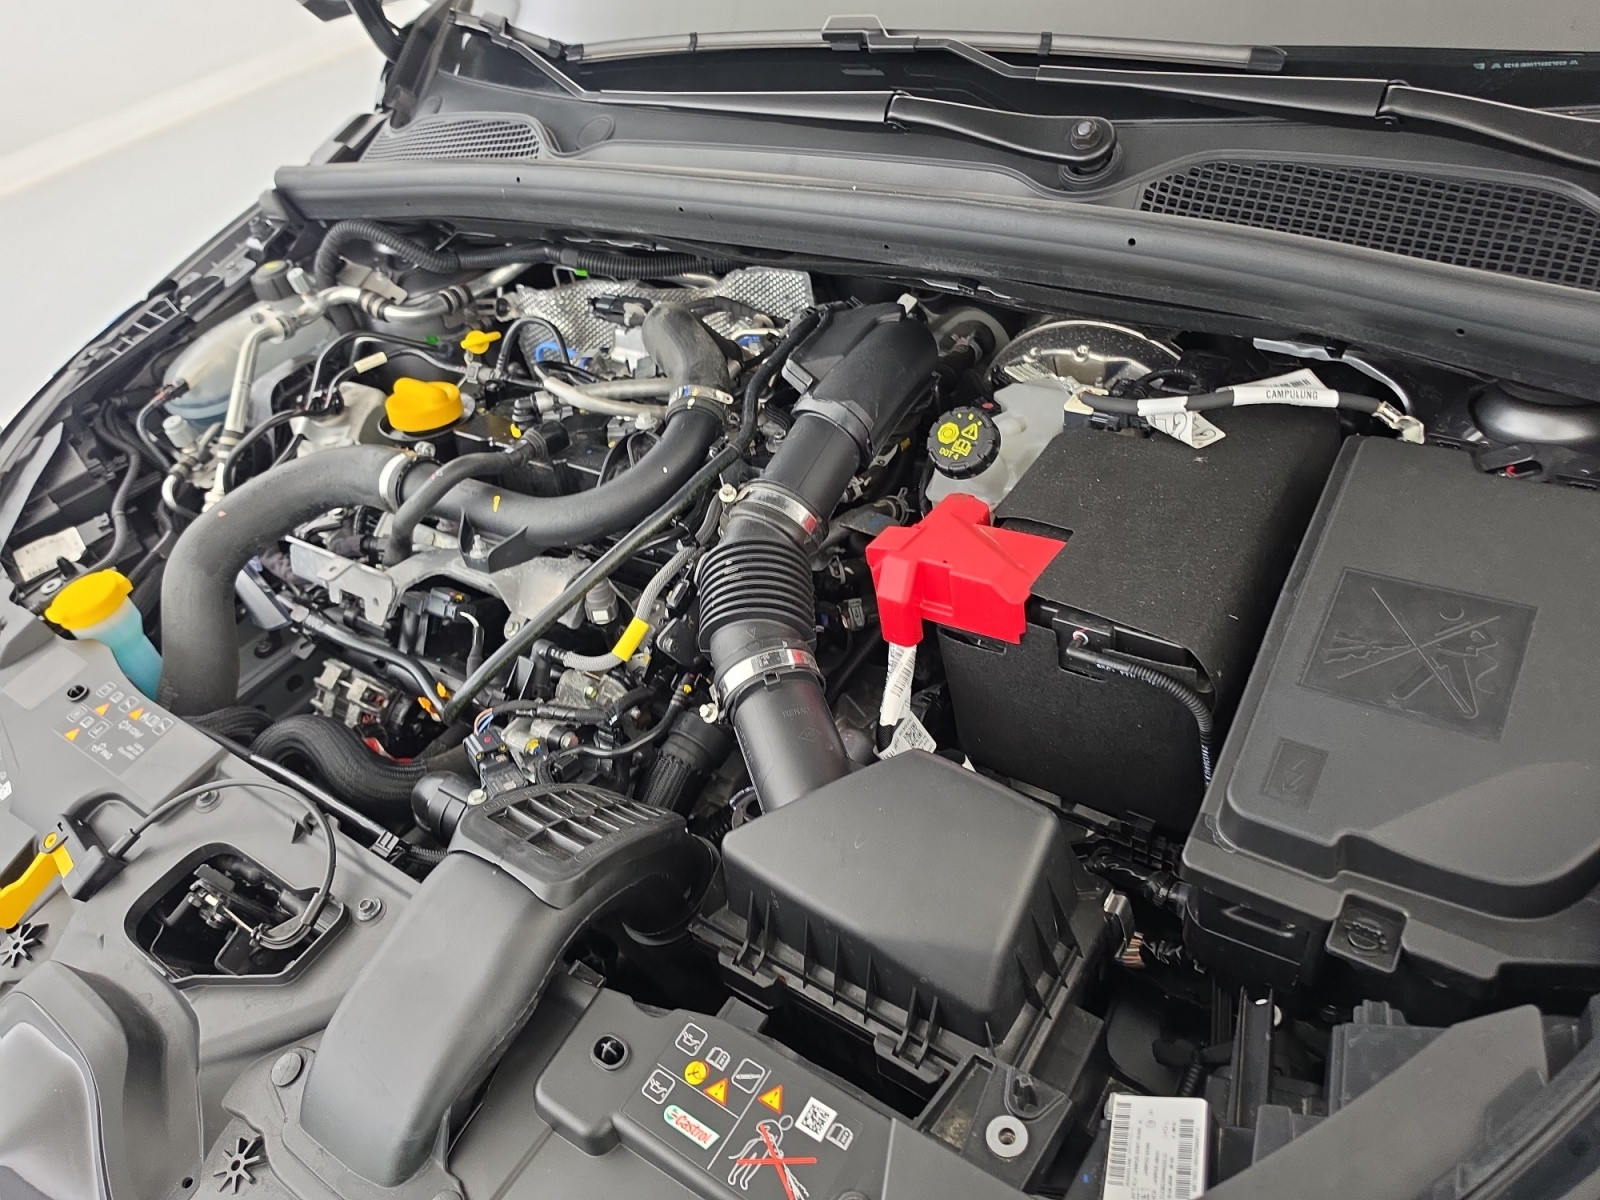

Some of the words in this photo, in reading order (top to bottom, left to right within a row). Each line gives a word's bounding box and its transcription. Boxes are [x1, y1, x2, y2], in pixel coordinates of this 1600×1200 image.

[1266, 389, 1319, 400] CAMPULUNG
[939, 447, 954, 458] DOT
[952, 453, 960, 461] 4
[675, 1114, 713, 1145] Castrol
